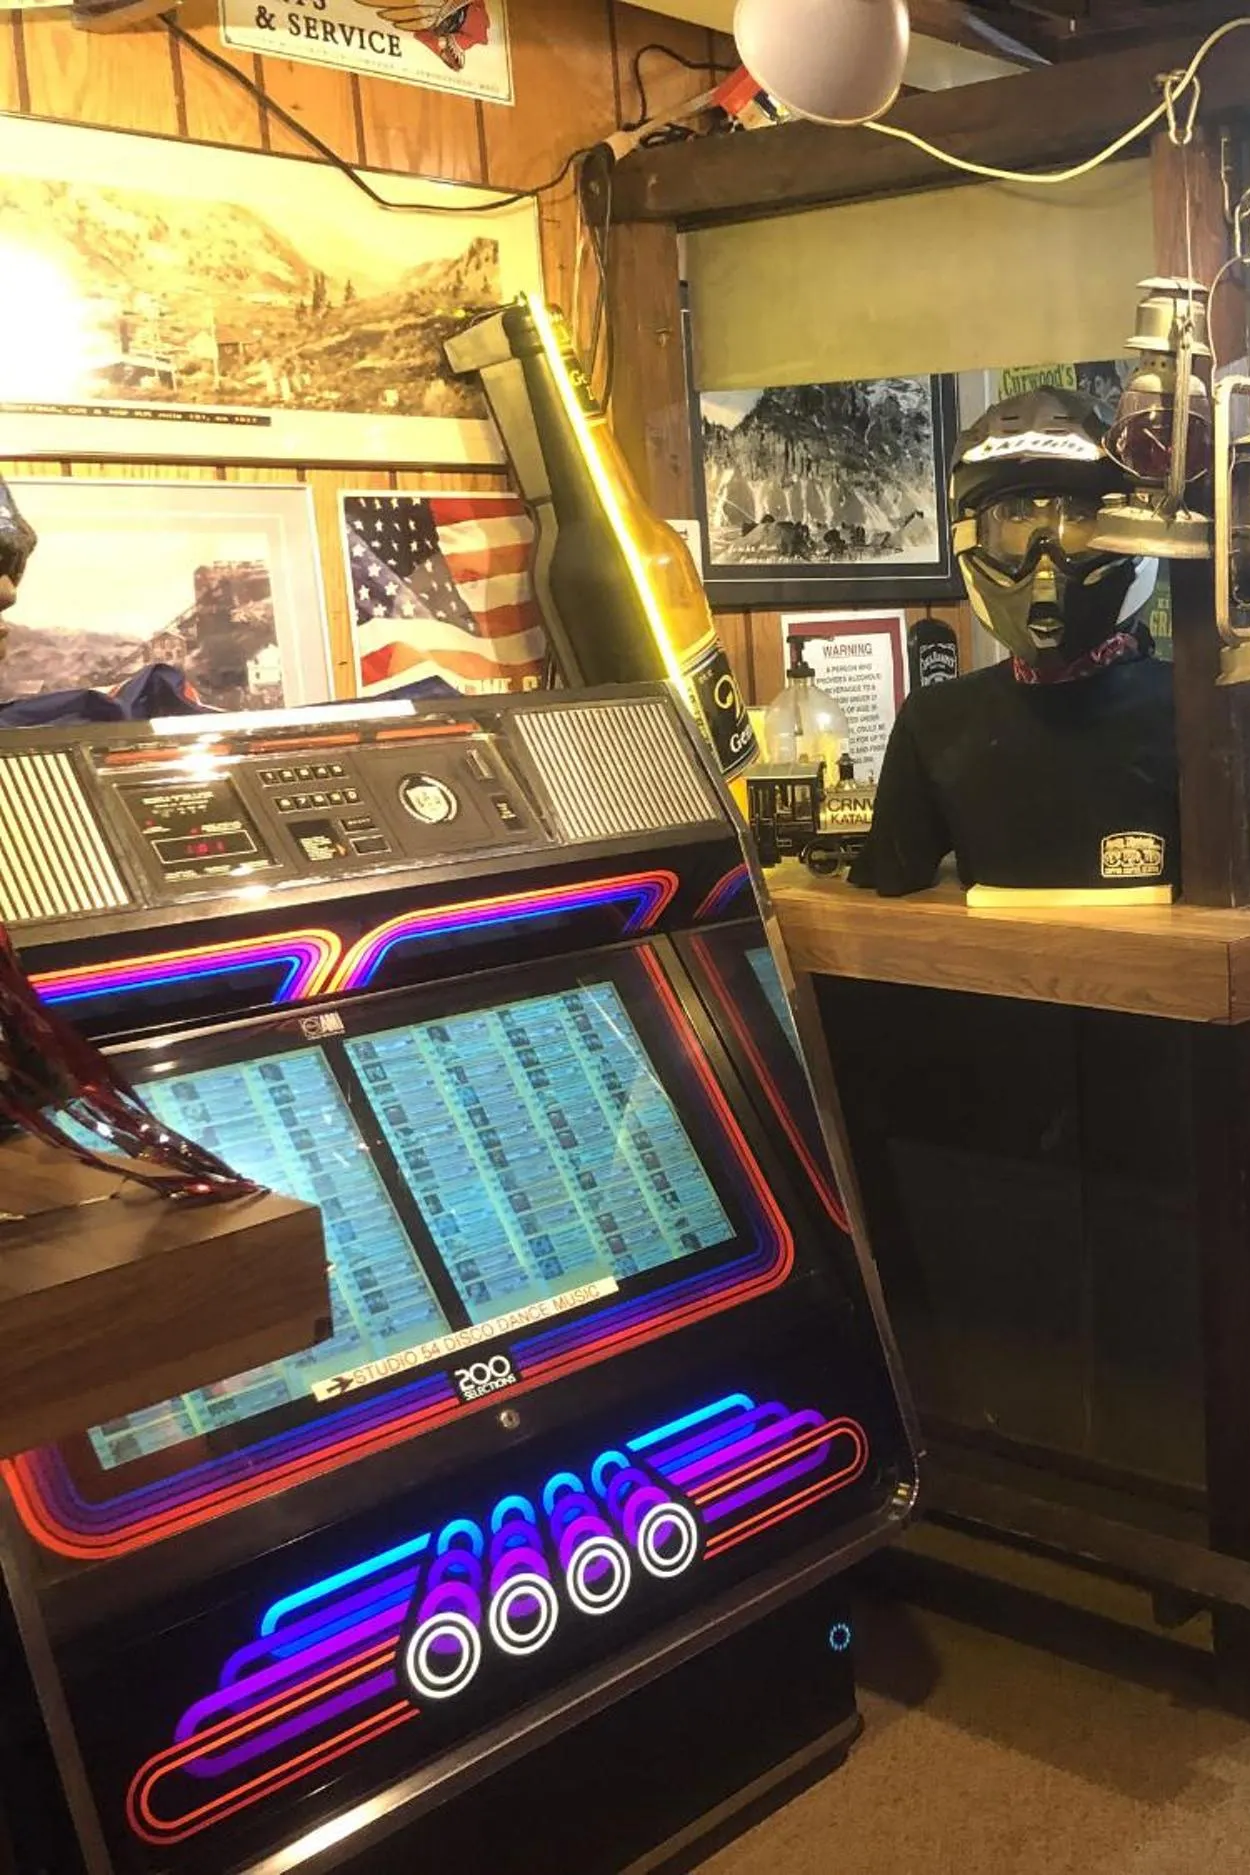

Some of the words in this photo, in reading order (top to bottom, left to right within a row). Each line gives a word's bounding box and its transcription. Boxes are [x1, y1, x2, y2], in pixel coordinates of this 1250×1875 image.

[255, 5, 276, 31] &
[288, 12, 402, 57] SERVICE
[823, 643, 873, 657] WARNING
[353, 1355, 417, 1385] STUDIO
[422, 1340, 441, 1357] 54
[443, 1324, 494, 1351] DISCO
[498, 1304, 549, 1331] DANCE
[554, 1284, 600, 1313] MUSIC
[454, 1355, 511, 1390] 200
[465, 1373, 516, 1400] SELECTIONS
